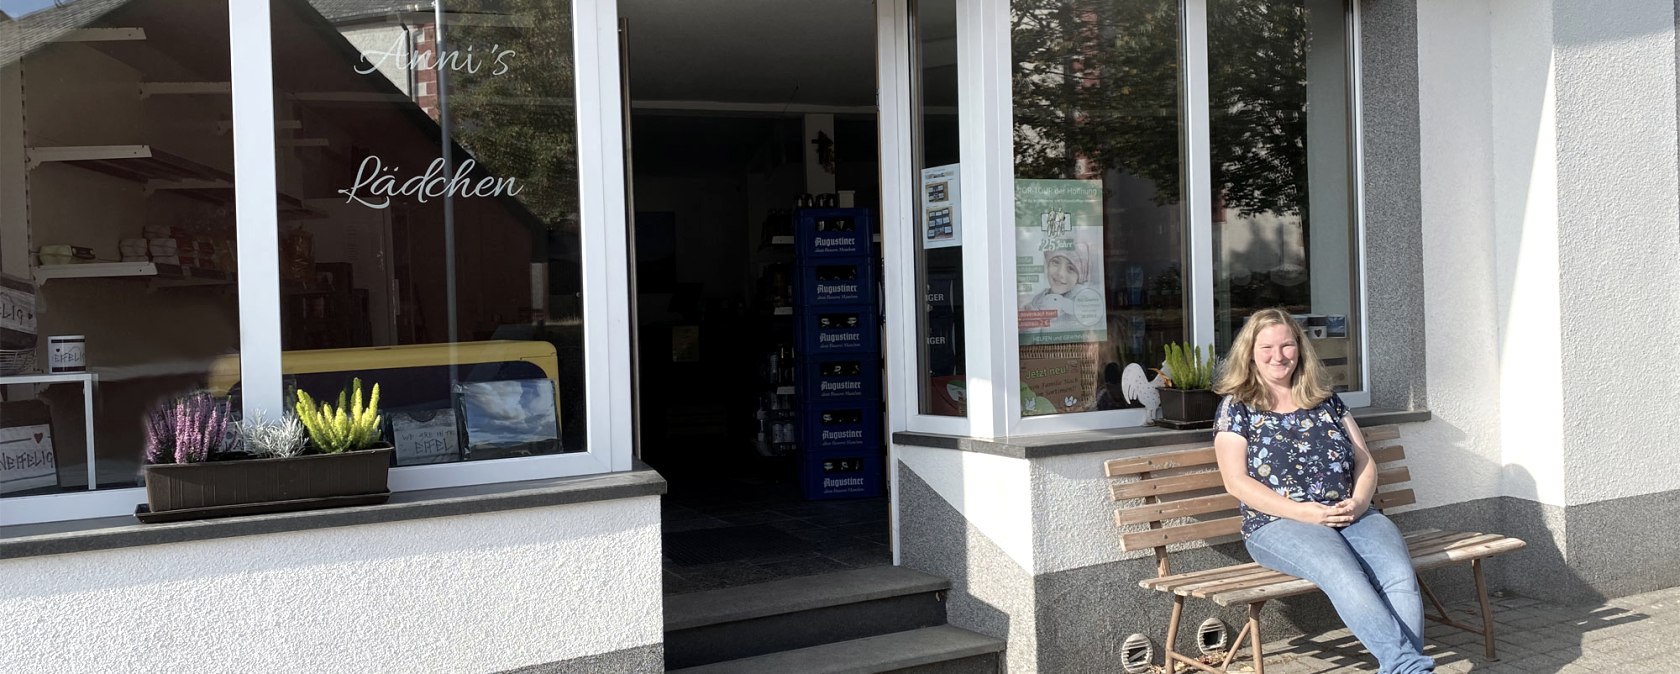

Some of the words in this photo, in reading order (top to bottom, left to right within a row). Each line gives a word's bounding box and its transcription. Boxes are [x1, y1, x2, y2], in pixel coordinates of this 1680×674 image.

[354, 30, 516, 76] Anni's
[338, 155, 525, 209] Lädchen
[815, 237, 855, 247] Augustiner
[1042, 239, 1056, 251] 25
[817, 284, 857, 294] Augustiner
[0, 303, 23, 326] LIG
[819, 332, 860, 342] Augustiner
[821, 381, 861, 391] Augustiner
[822, 430, 863, 440] Augustiner
[823, 477, 864, 488] Augustiner
